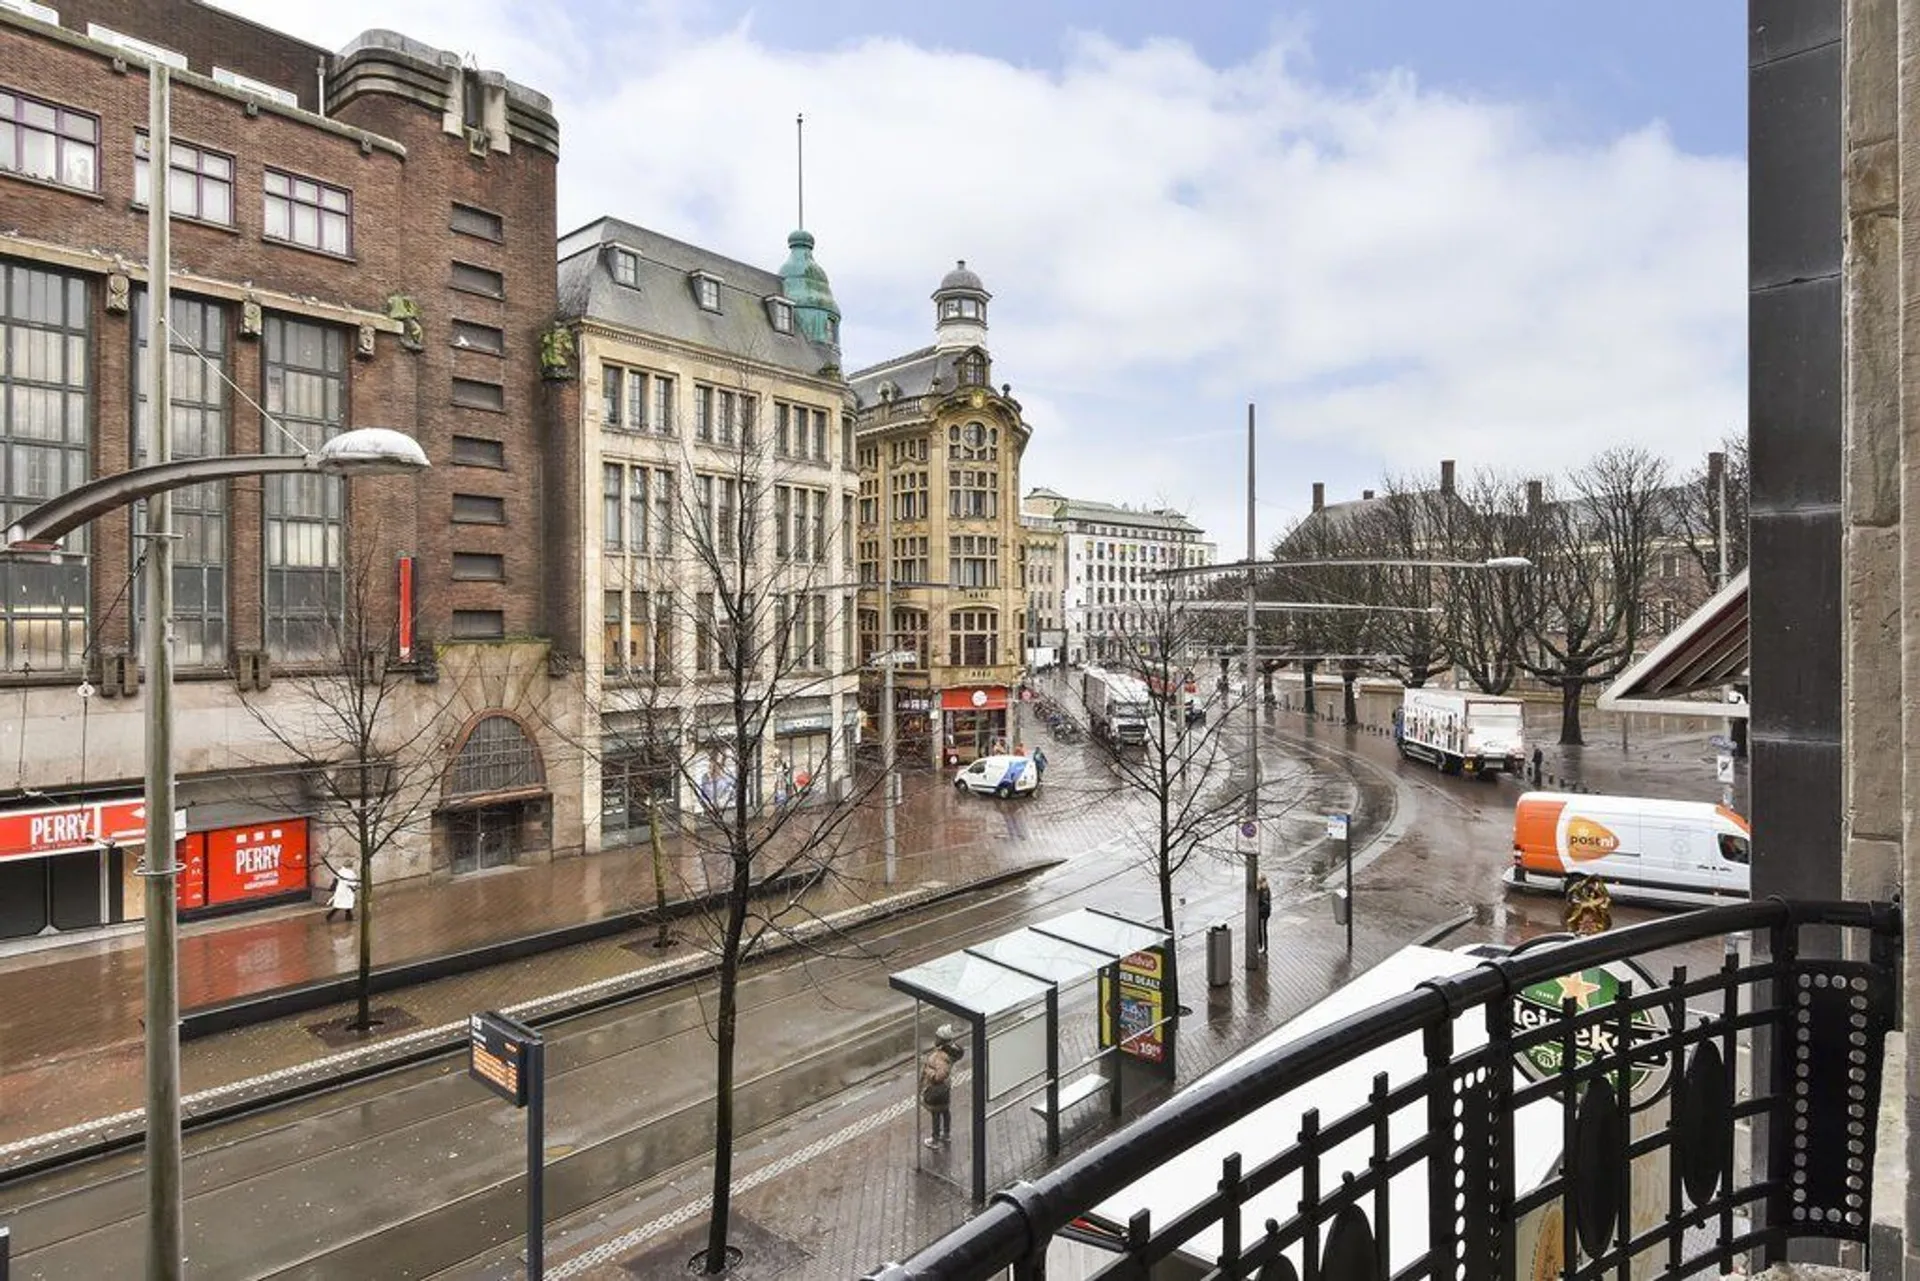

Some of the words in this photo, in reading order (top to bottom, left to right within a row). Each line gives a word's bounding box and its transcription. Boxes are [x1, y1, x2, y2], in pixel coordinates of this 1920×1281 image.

[31, 812, 90, 845] PERRY
[1570, 835, 1614, 848] postnl
[236, 844, 282, 875] PERRY
